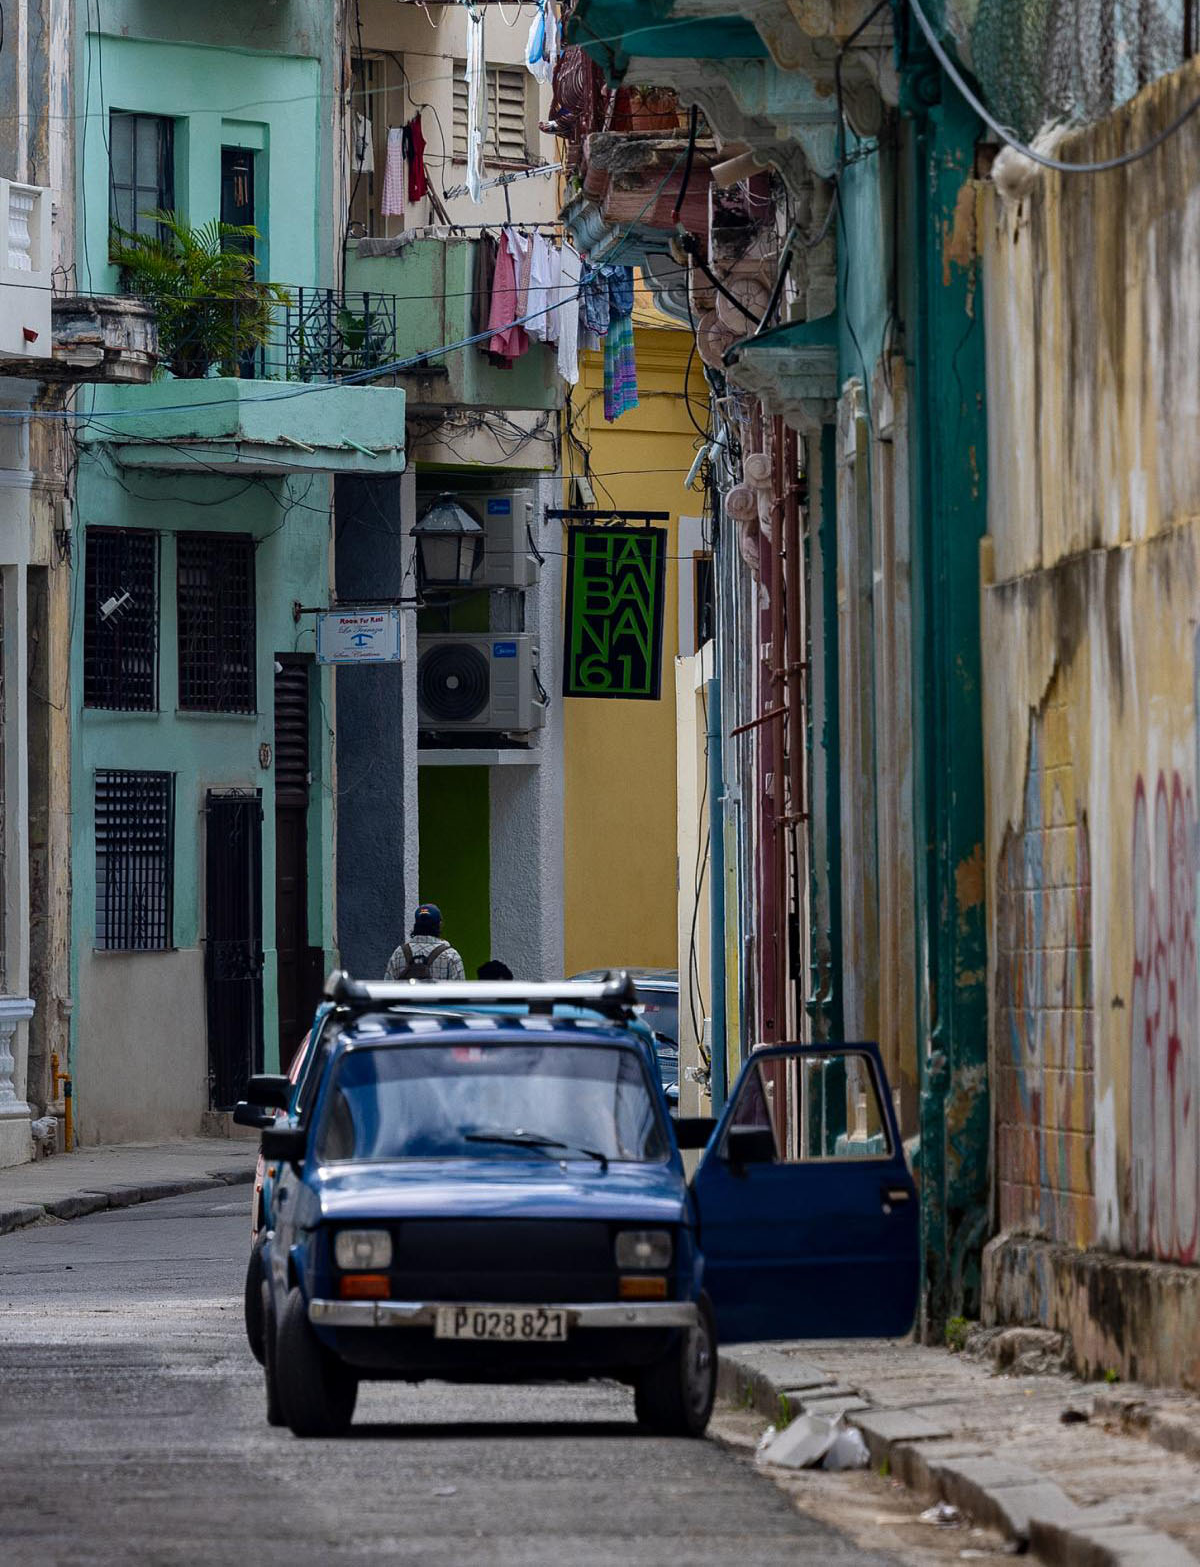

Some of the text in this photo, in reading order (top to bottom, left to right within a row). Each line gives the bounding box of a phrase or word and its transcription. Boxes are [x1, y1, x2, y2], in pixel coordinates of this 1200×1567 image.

[579, 655, 632, 690] 61
[455, 1310, 468, 1336] P
[473, 1312, 515, 1338] 028
[521, 1313, 563, 1338] 821
